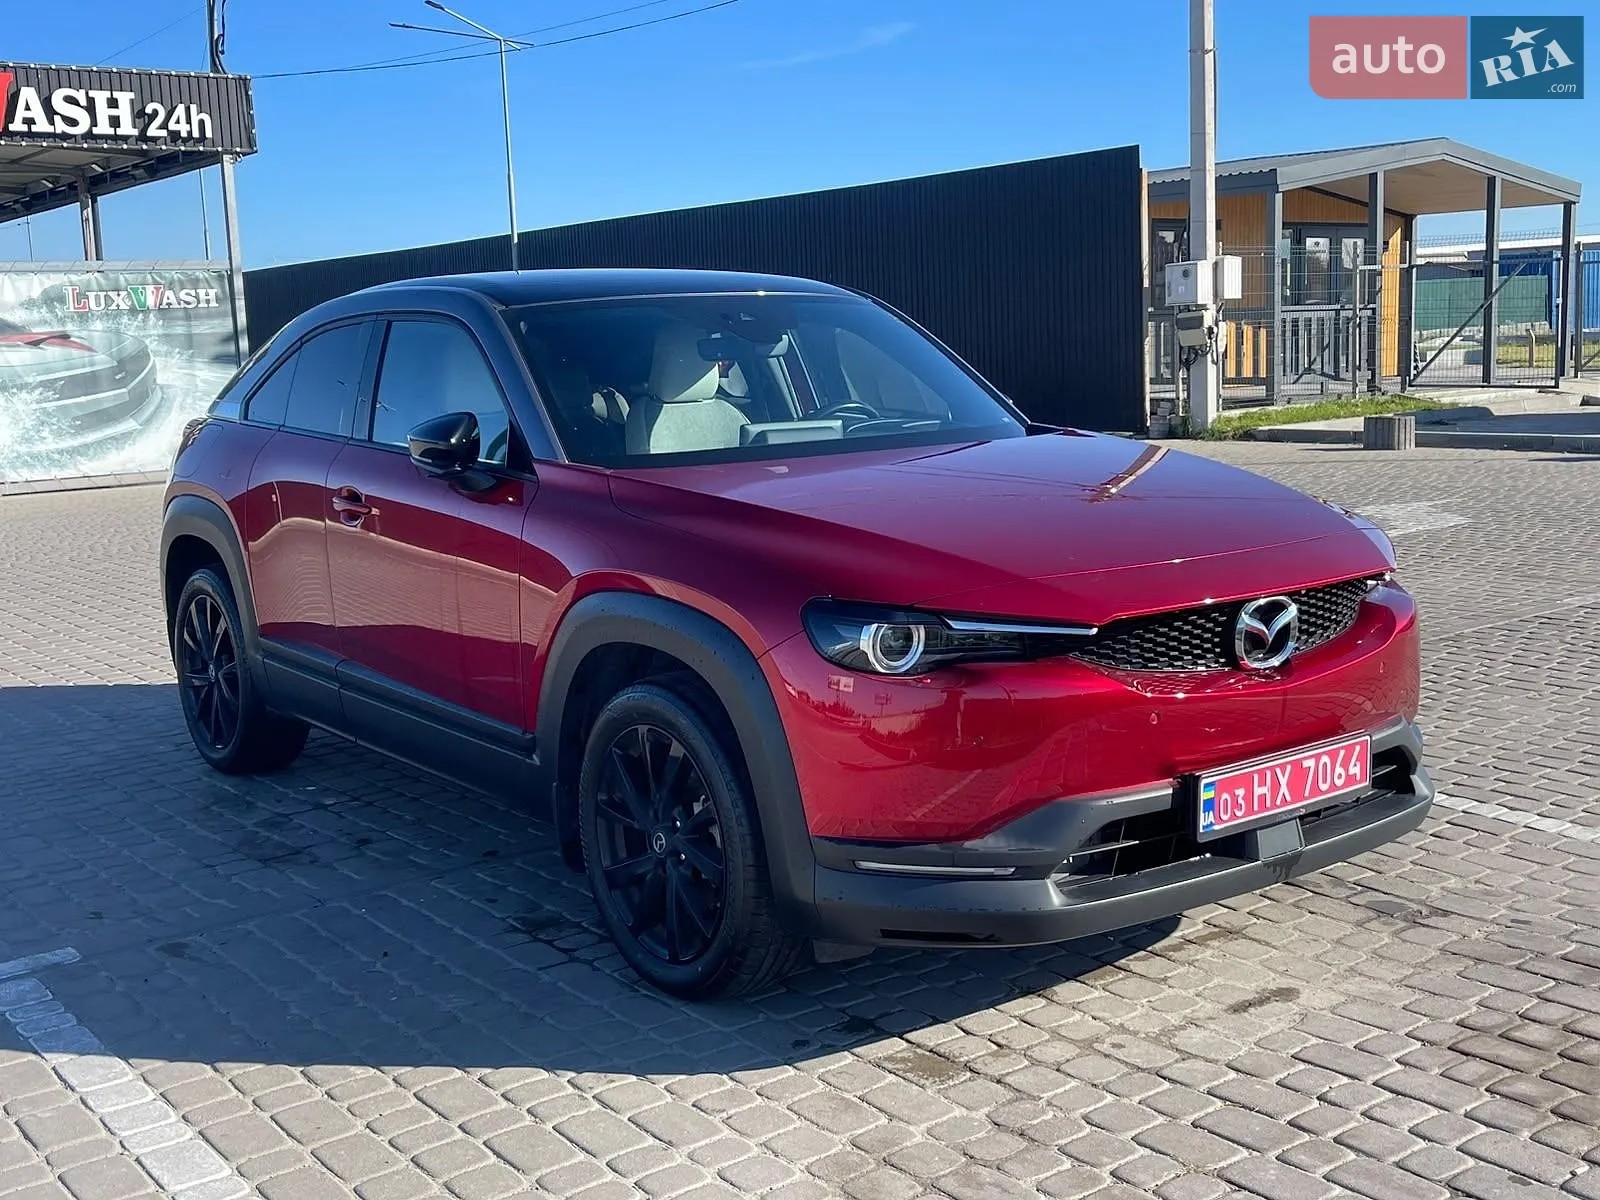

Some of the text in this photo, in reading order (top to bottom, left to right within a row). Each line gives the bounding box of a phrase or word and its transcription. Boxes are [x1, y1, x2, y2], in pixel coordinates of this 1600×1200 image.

[144, 102, 213, 139] 24h
[1219, 745, 1361, 821] 03 HX 7064
[1202, 812, 1215, 825] UA
